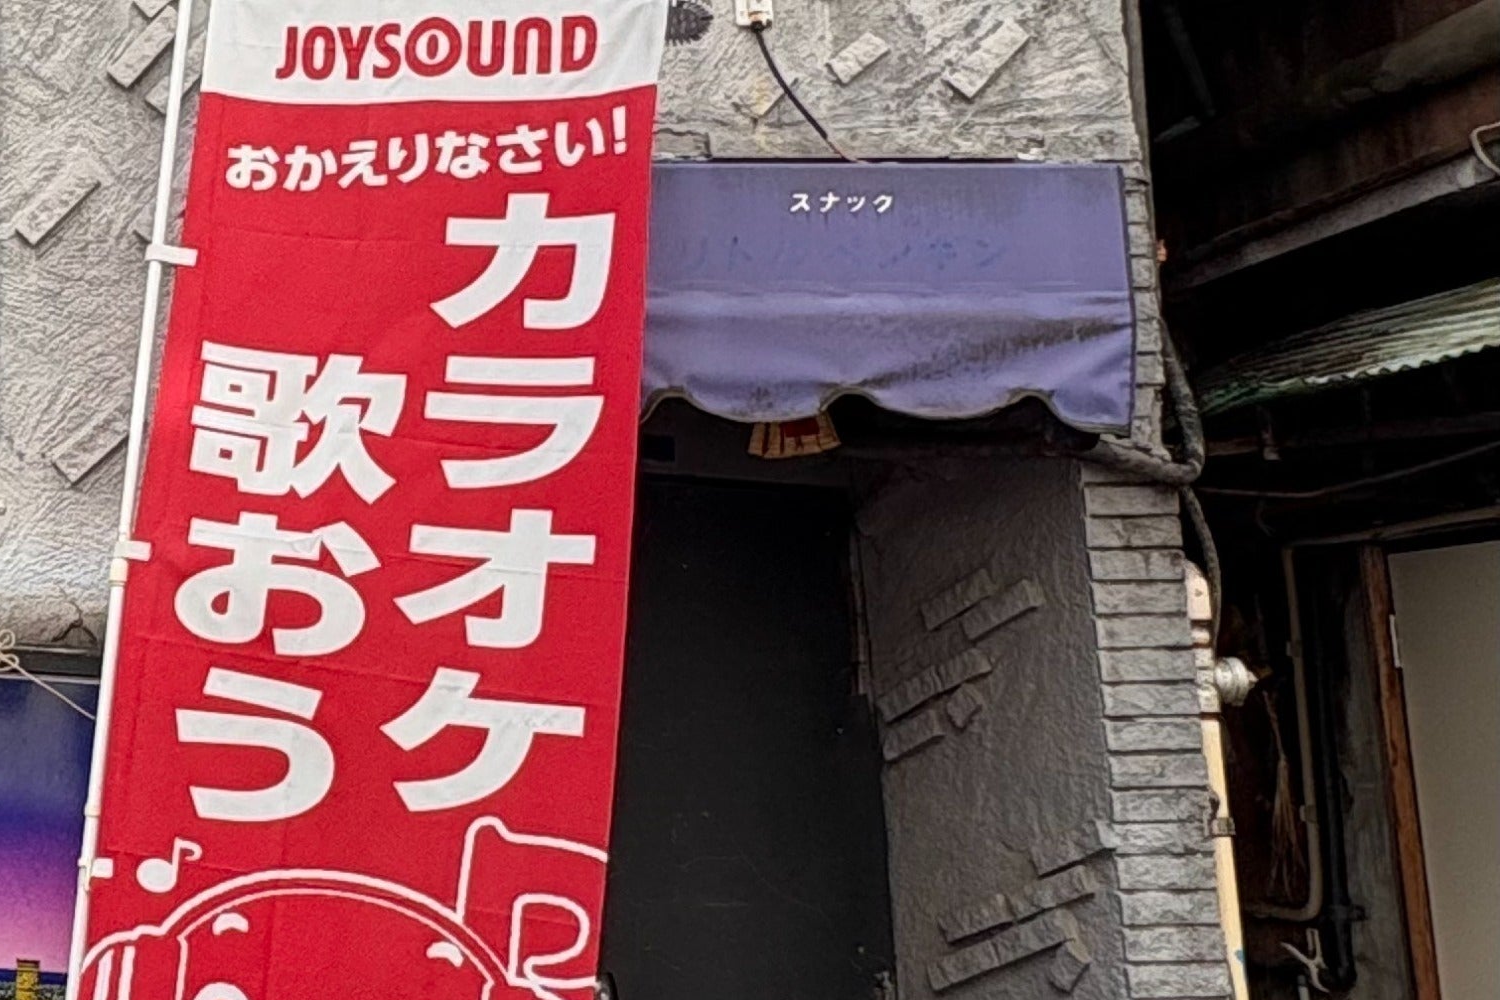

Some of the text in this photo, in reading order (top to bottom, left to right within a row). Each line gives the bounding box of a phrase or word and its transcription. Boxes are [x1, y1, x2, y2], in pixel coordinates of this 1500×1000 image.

[276, 16, 597, 80] JOYSOUND
[790, 192, 893, 213] スナック
[174, 341, 407, 822] 歌おう
[380, 192, 615, 812] カラオケ
